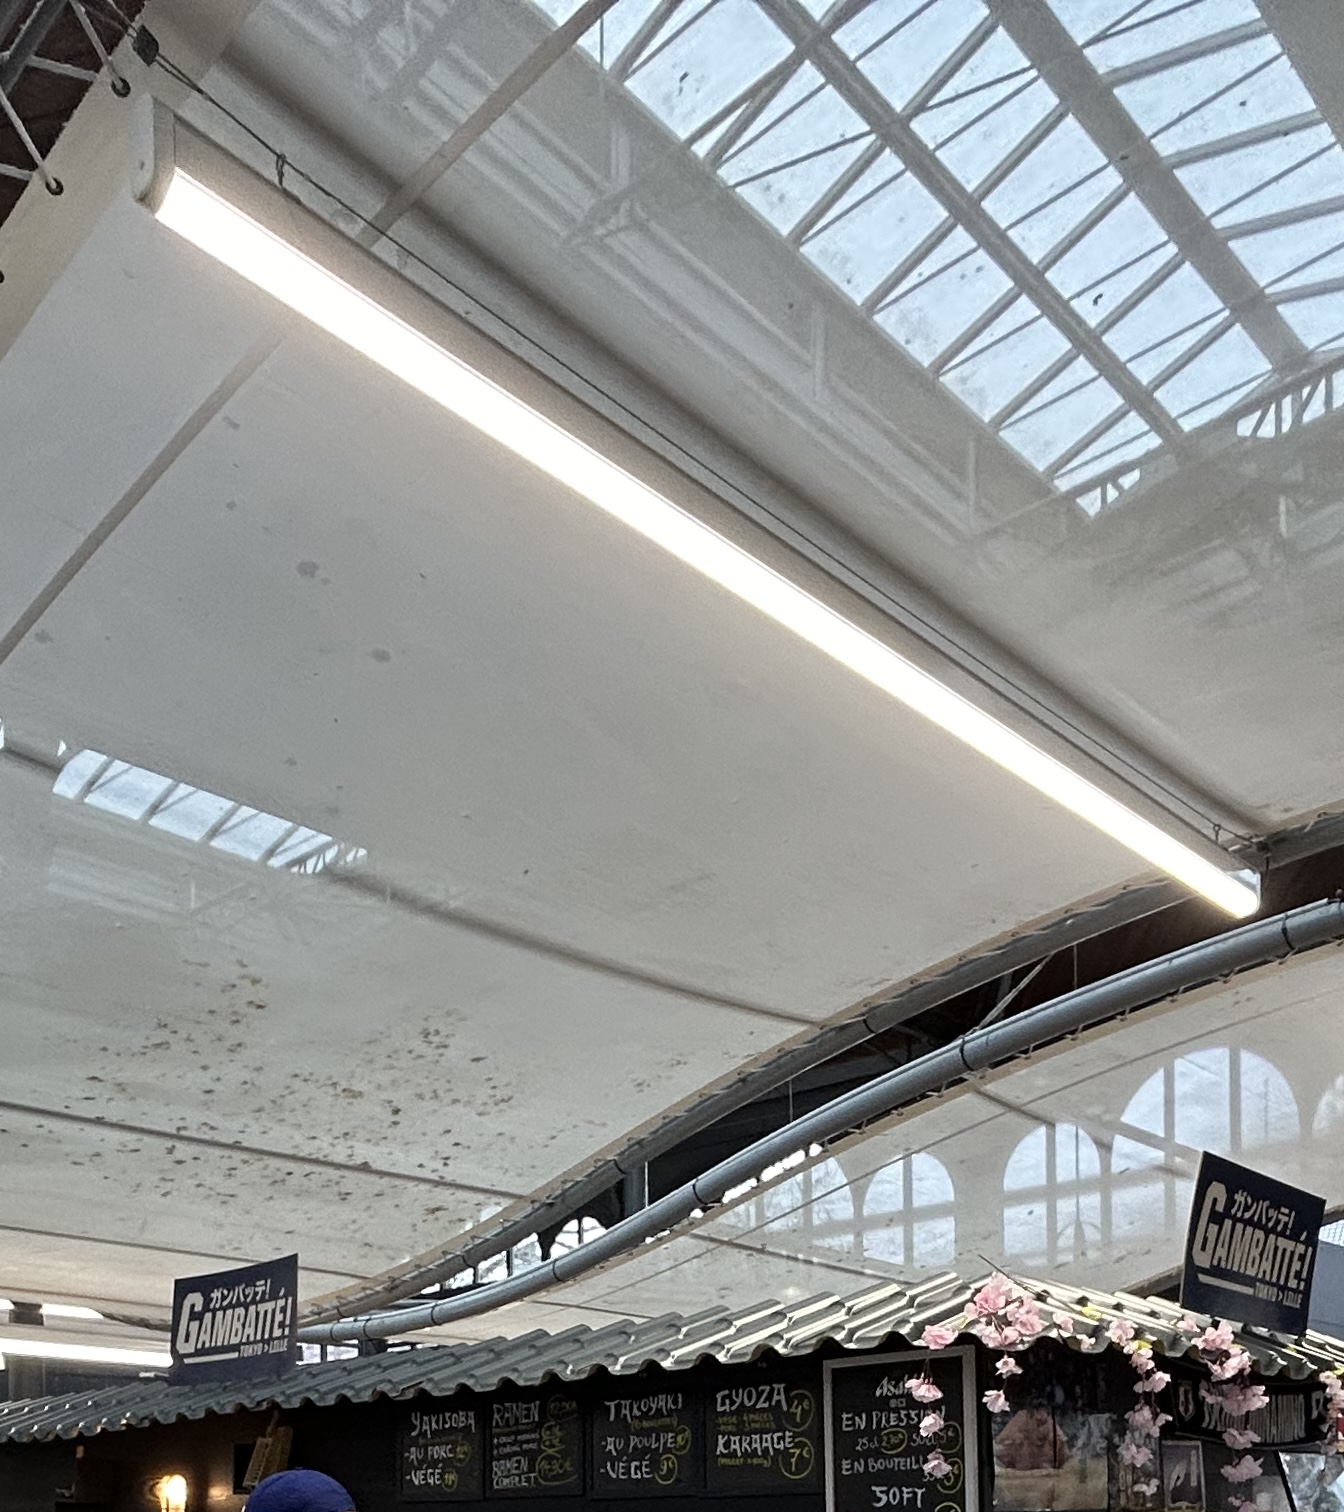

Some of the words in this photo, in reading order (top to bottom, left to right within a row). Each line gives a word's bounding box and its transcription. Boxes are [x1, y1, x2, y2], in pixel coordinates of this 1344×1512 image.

[1192, 1181, 1313, 1291] GAMBATTÉ!
[176, 1287, 293, 1355] GAMBATTÉ!
[604, 1393, 683, 1424] TAKOYAKI
[715, 1383, 788, 1412] GYOZA
[411, 1410, 476, 1438] YAKISOBA
[492, 1401, 540, 1428] RAMEN
[841, 1411, 867, 1431] EN
[872, 1405, 946, 1430] PRESSIN
[715, 1430, 795, 1457] KARAAGE
[841, 1457, 865, 1476] EN
[870, 1485, 926, 1509] SOFT
